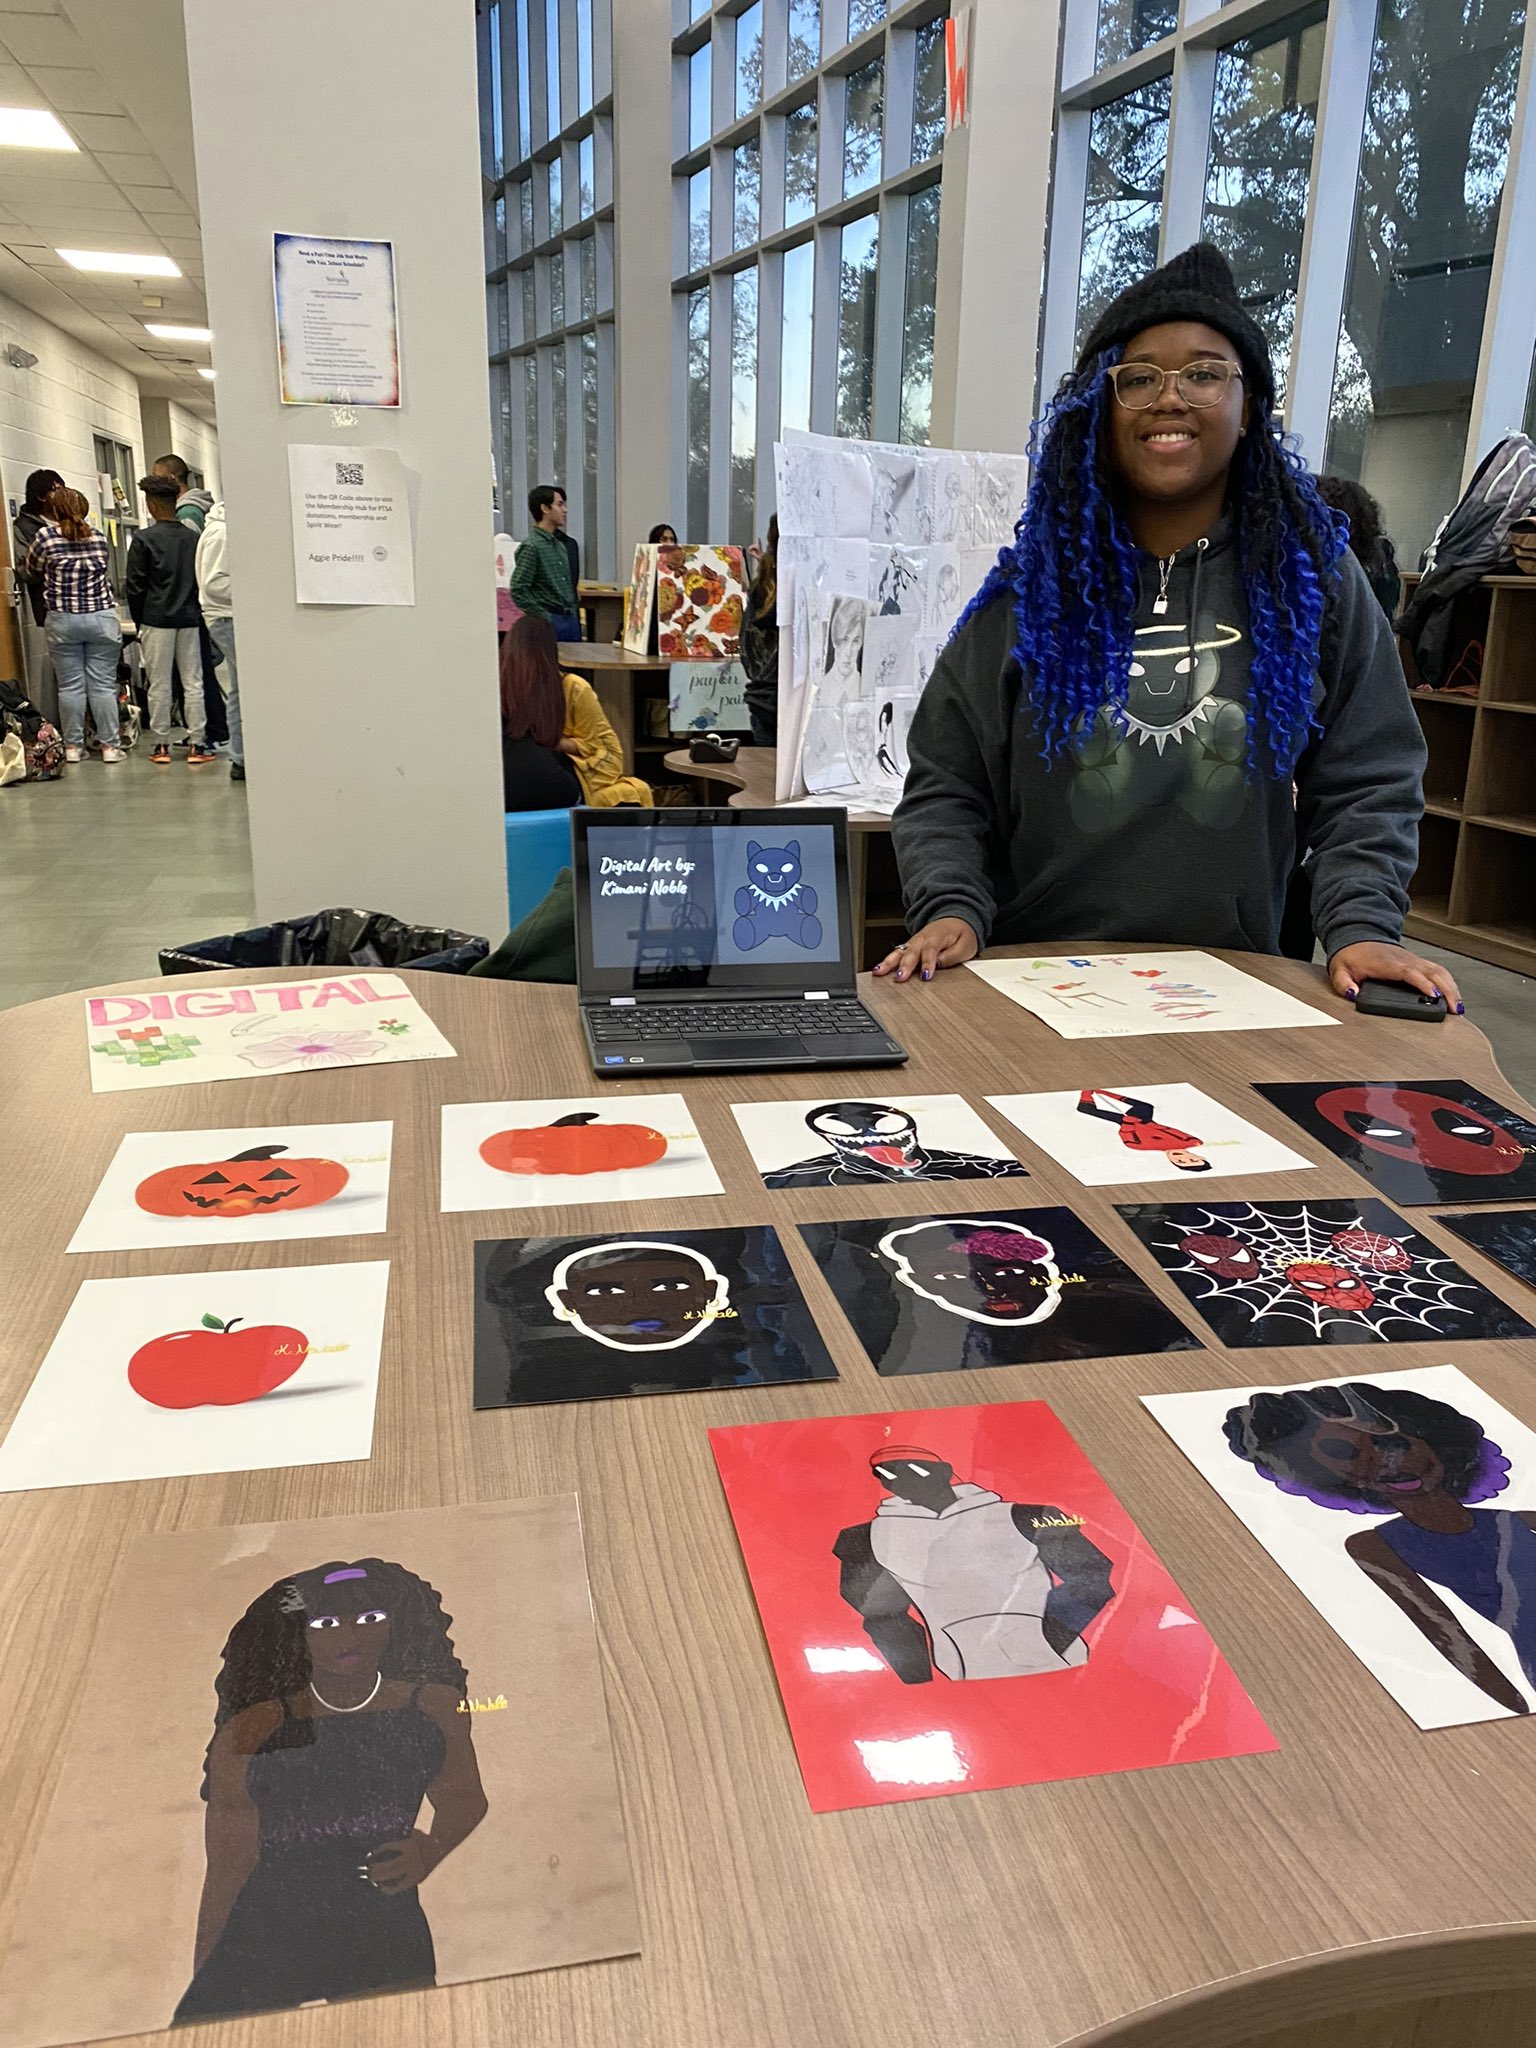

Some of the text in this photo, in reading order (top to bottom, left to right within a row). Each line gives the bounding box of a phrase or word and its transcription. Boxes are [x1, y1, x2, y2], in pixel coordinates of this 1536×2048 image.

[306, 512, 337, 520] donations,
[317, 503, 354, 511] Membership
[306, 521, 323, 529] Spirit
[309, 553, 331, 563] Aggie
[689, 671, 740, 700] payton
[719, 694, 746, 715] pai
[600, 856, 696, 877] Digital Art by:
[600, 878, 688, 897] Kimani Noble
[89, 978, 411, 1026] DIGITAL
